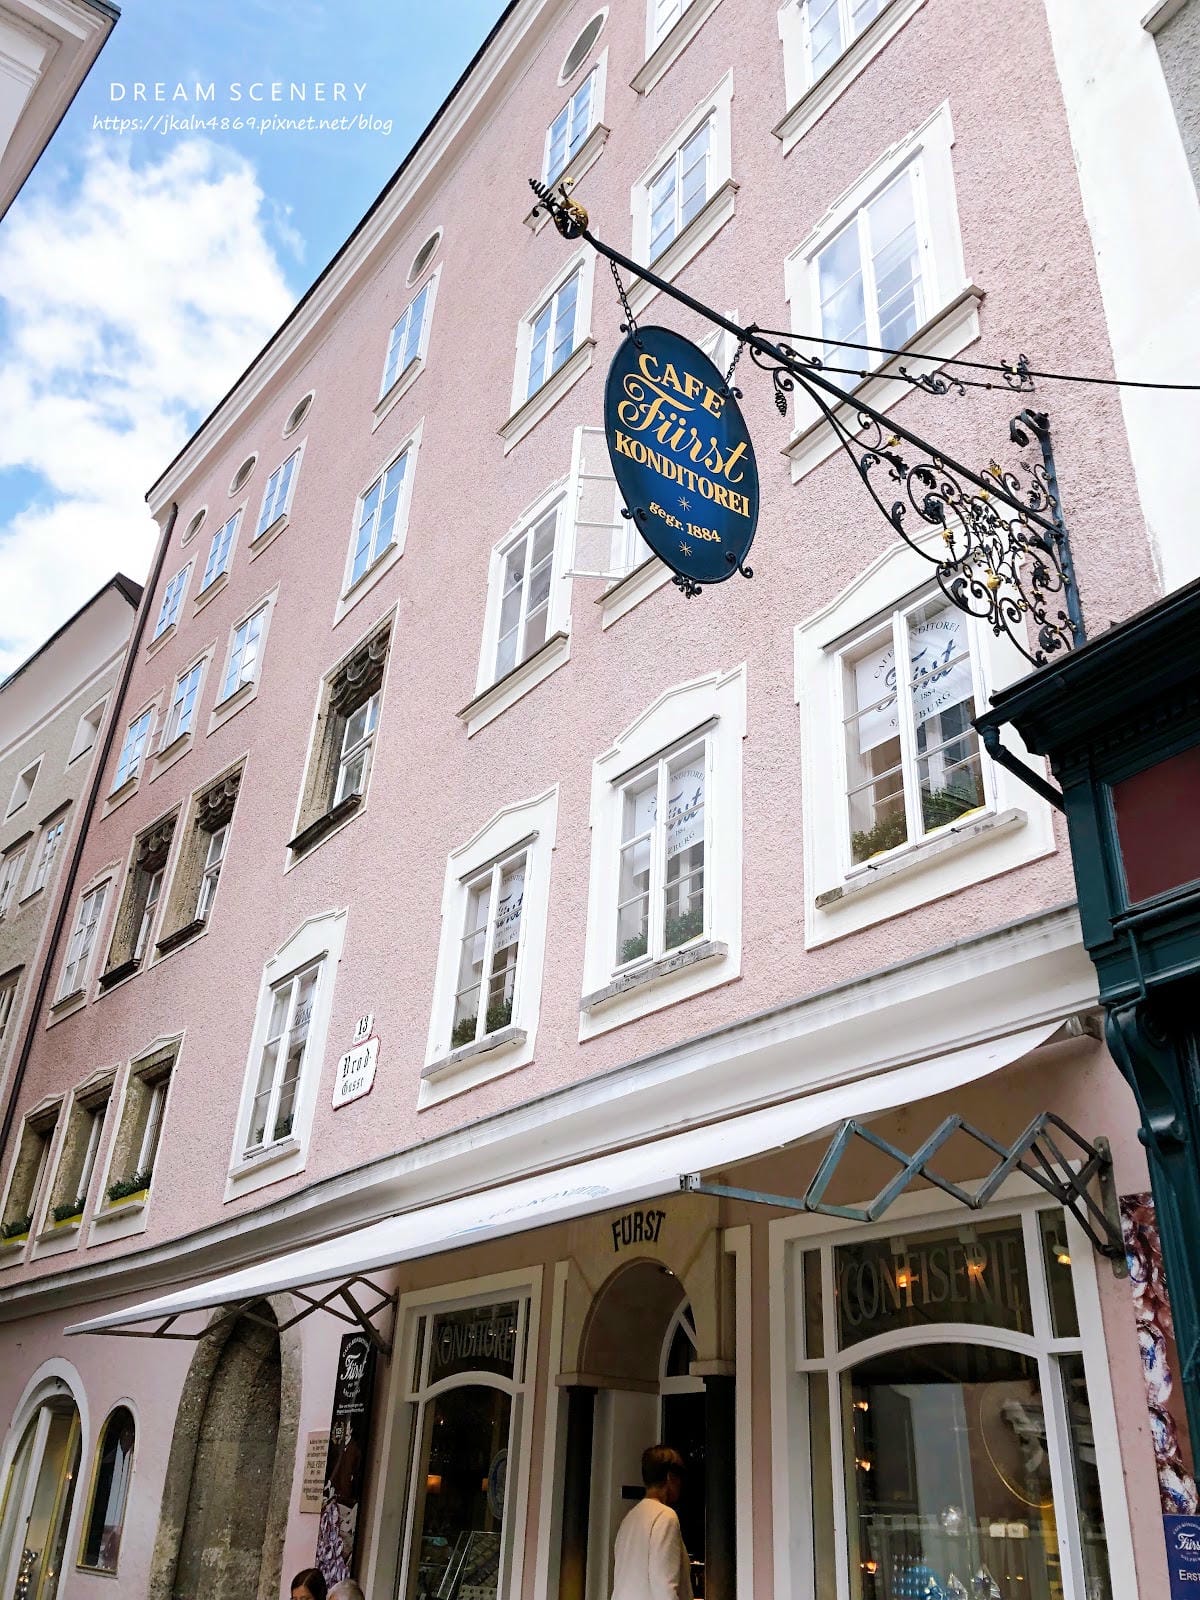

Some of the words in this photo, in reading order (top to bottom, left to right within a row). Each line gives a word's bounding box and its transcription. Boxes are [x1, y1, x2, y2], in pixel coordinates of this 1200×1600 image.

[638, 353, 725, 419] CAFE
[617, 373, 748, 483] Fürst
[614, 429, 751, 518] KONDITOREI
[649, 501, 684, 531] gegr.
[687, 522, 722, 543] 1884
[910, 621, 960, 636] NDITOREI
[357, 1015, 369, 1036] 13
[840, 1236, 1023, 1327] CONFISERIE
